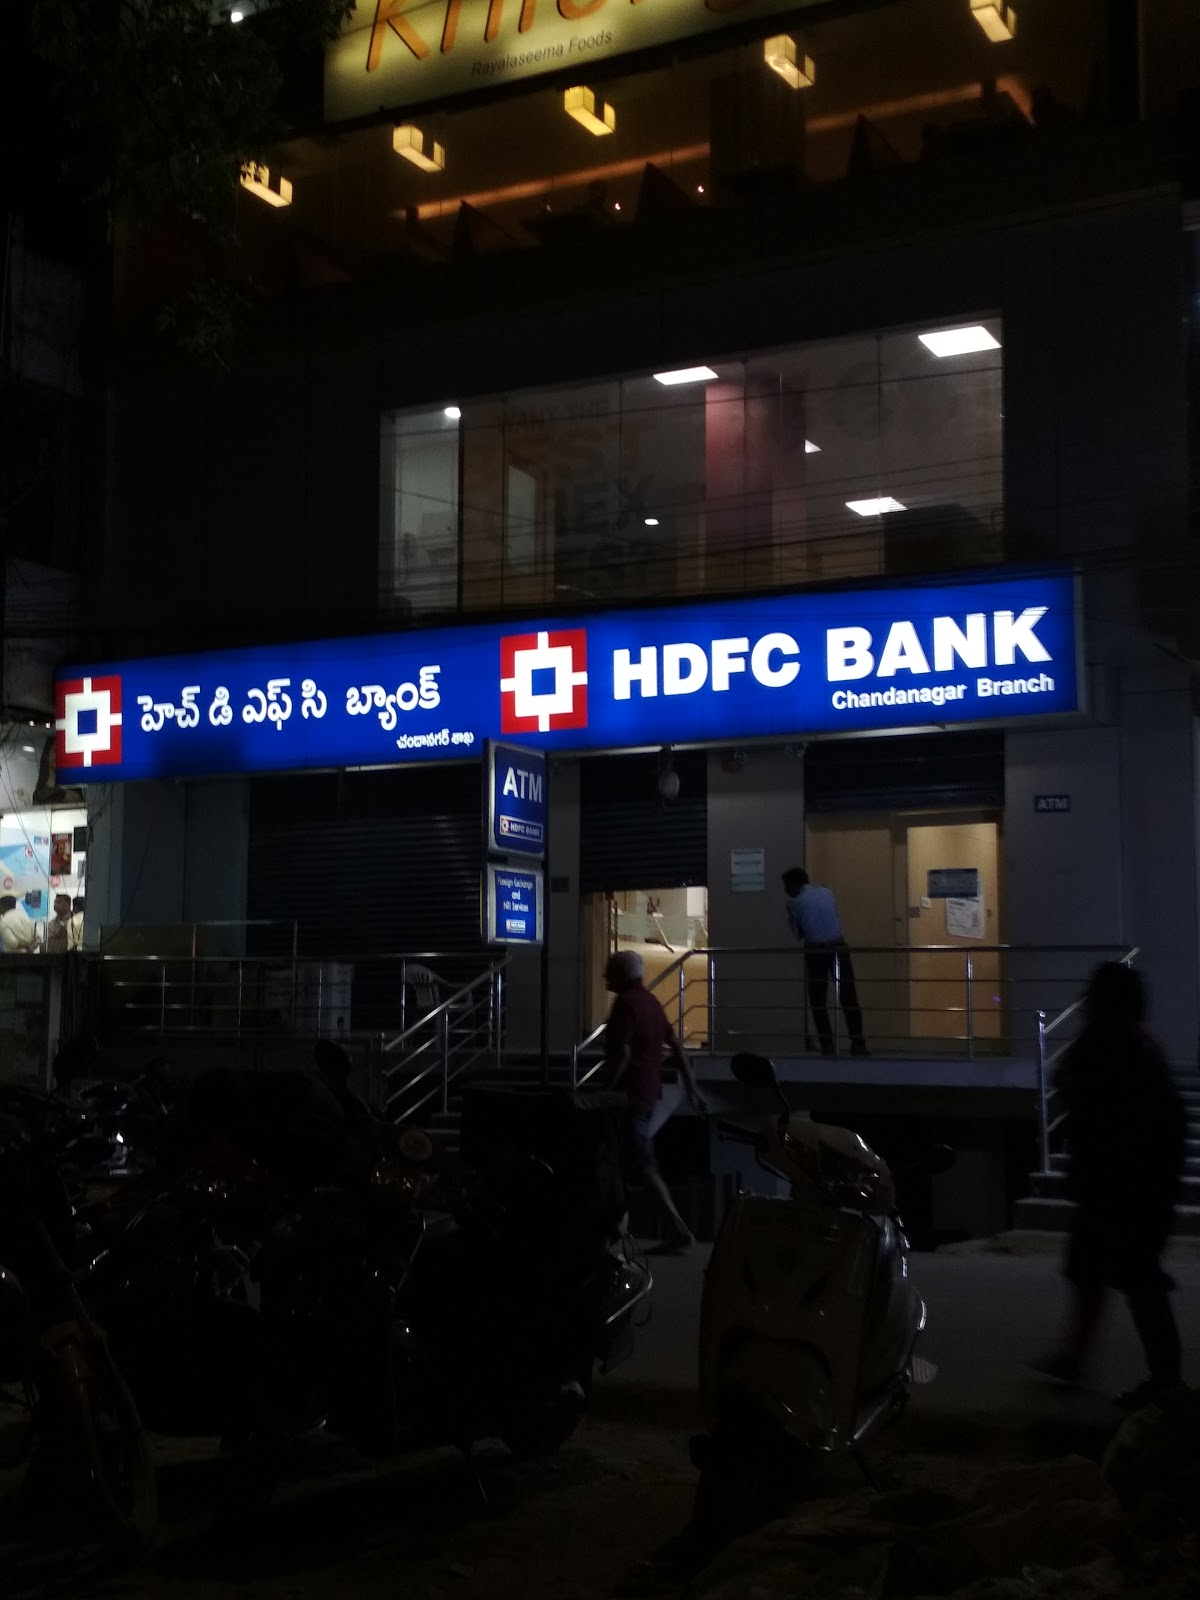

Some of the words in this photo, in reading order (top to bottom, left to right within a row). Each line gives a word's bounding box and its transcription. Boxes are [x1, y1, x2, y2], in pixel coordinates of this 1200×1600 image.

[471, 43, 564, 76] Rayalaseema
[568, 29, 613, 53] Foods
[614, 633, 800, 700] HDFC
[826, 606, 1053, 682] BANK
[137, 685, 200, 732] హెచ్
[209, 687, 232, 727] డి
[242, 679, 292, 731] ఎఫ్
[302, 679, 328, 719] సి
[346, 664, 441, 732] బ్యాంక్
[831, 685, 967, 711] Chandanagar
[976, 673, 1055, 699] Branch
[503, 766, 543, 804] ATM
[1037, 798, 1067, 809] ATM
